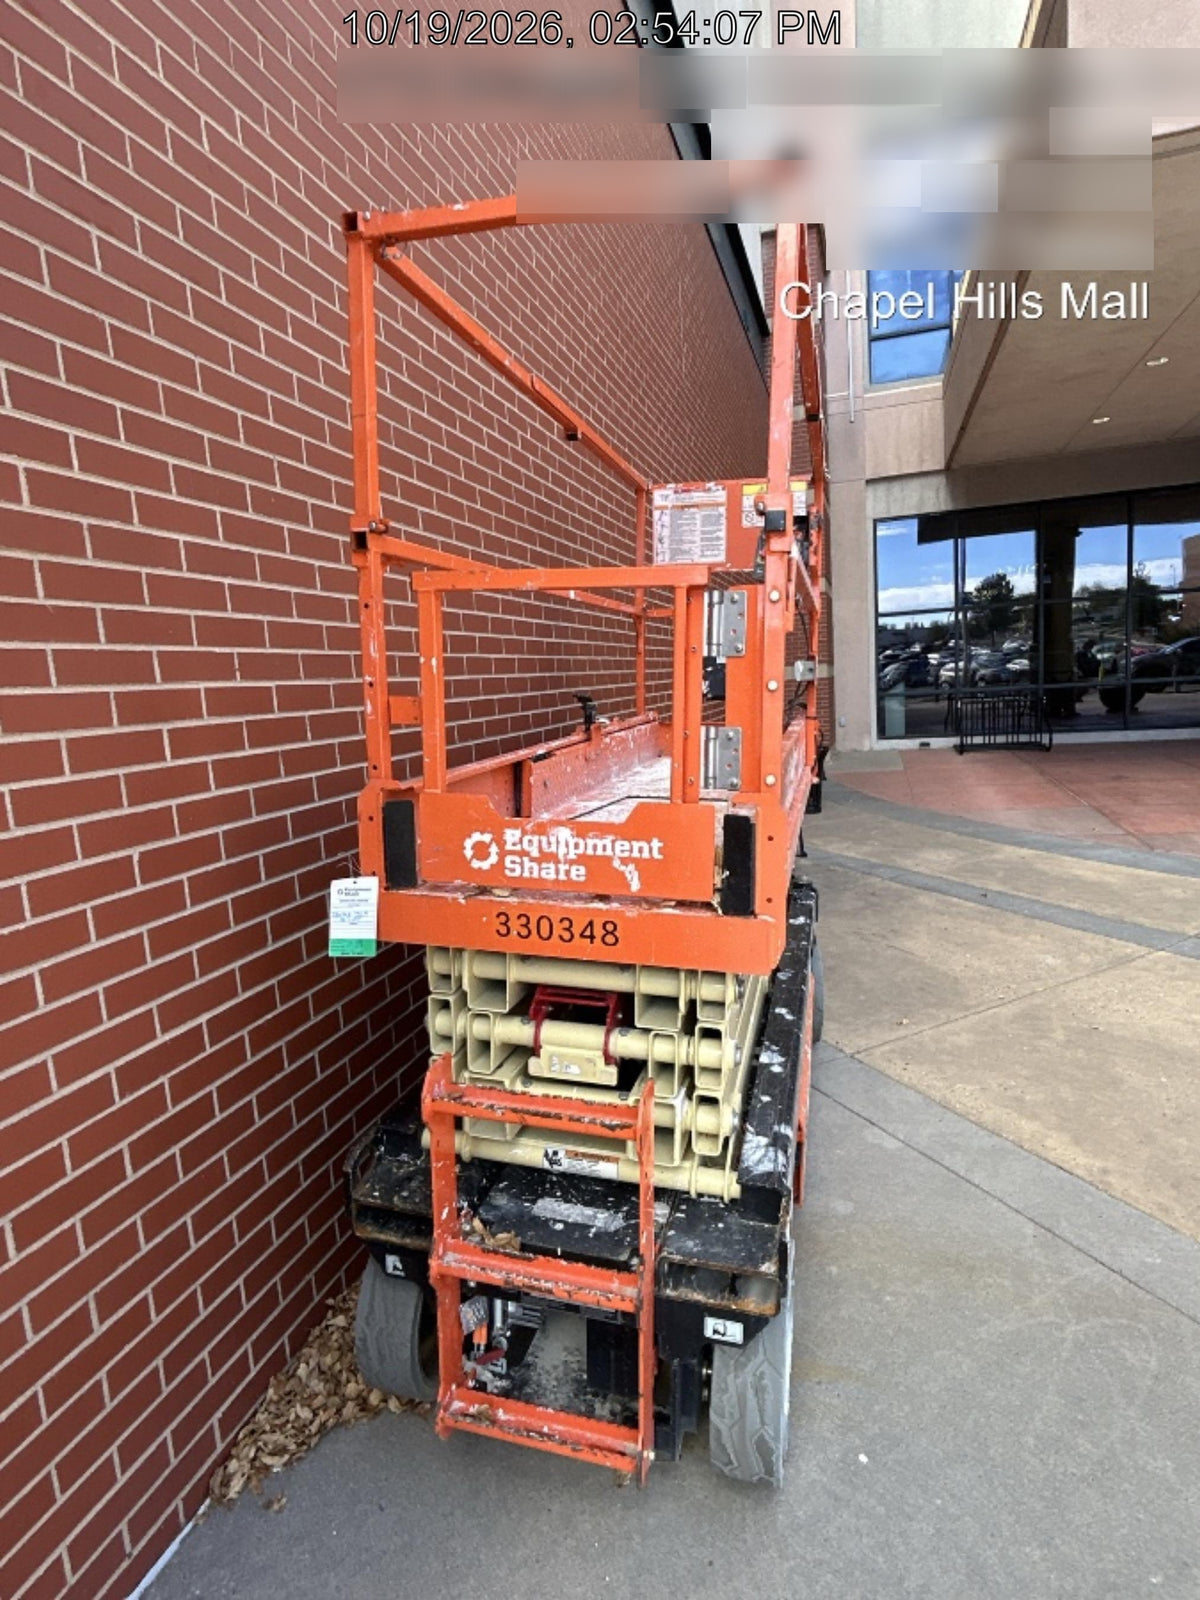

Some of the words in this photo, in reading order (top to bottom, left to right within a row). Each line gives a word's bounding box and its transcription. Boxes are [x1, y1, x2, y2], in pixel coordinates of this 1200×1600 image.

[503, 827, 664, 860] Equipment
[504, 855, 587, 881] Share
[495, 911, 619, 947] 330348
